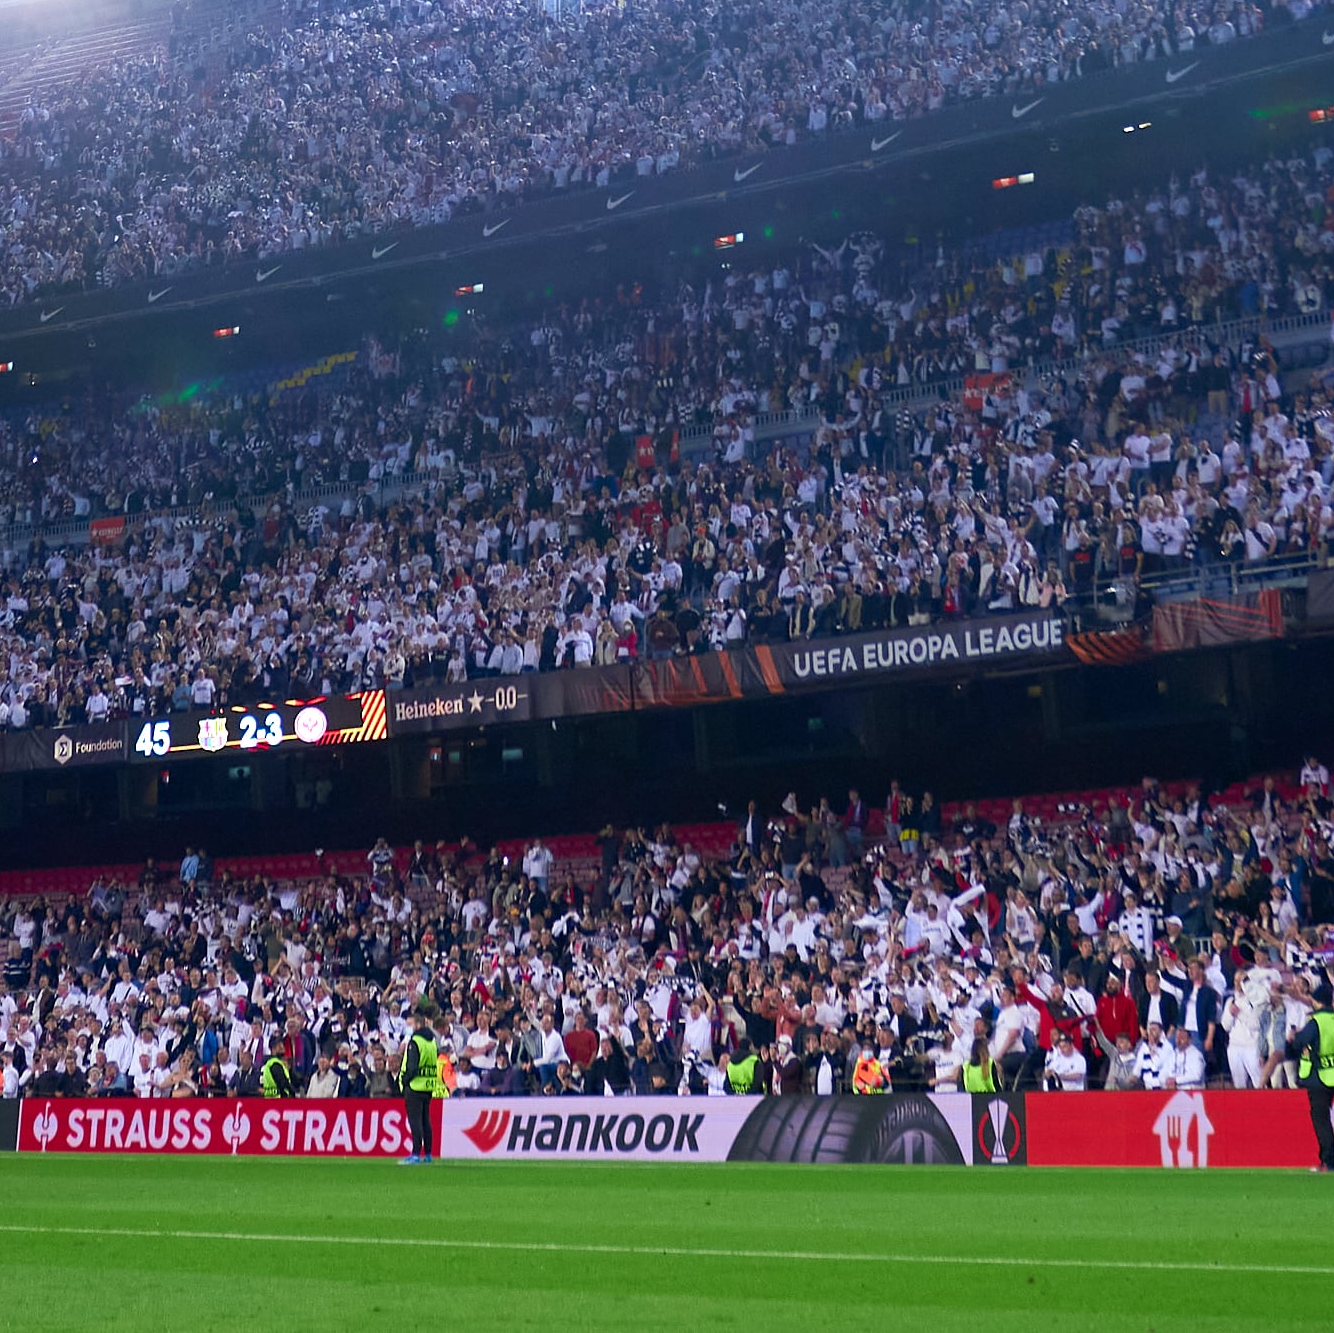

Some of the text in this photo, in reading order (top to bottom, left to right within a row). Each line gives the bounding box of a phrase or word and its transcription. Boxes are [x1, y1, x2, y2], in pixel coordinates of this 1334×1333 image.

[794, 619, 1062, 677] UEFA EUROPA LEAGUE
[395, 697, 463, 721] Heineken
[75, 736, 123, 754] Foundation
[136, 713, 282, 756] 45 2-3
[67, 1108, 212, 1150] STRAUSS
